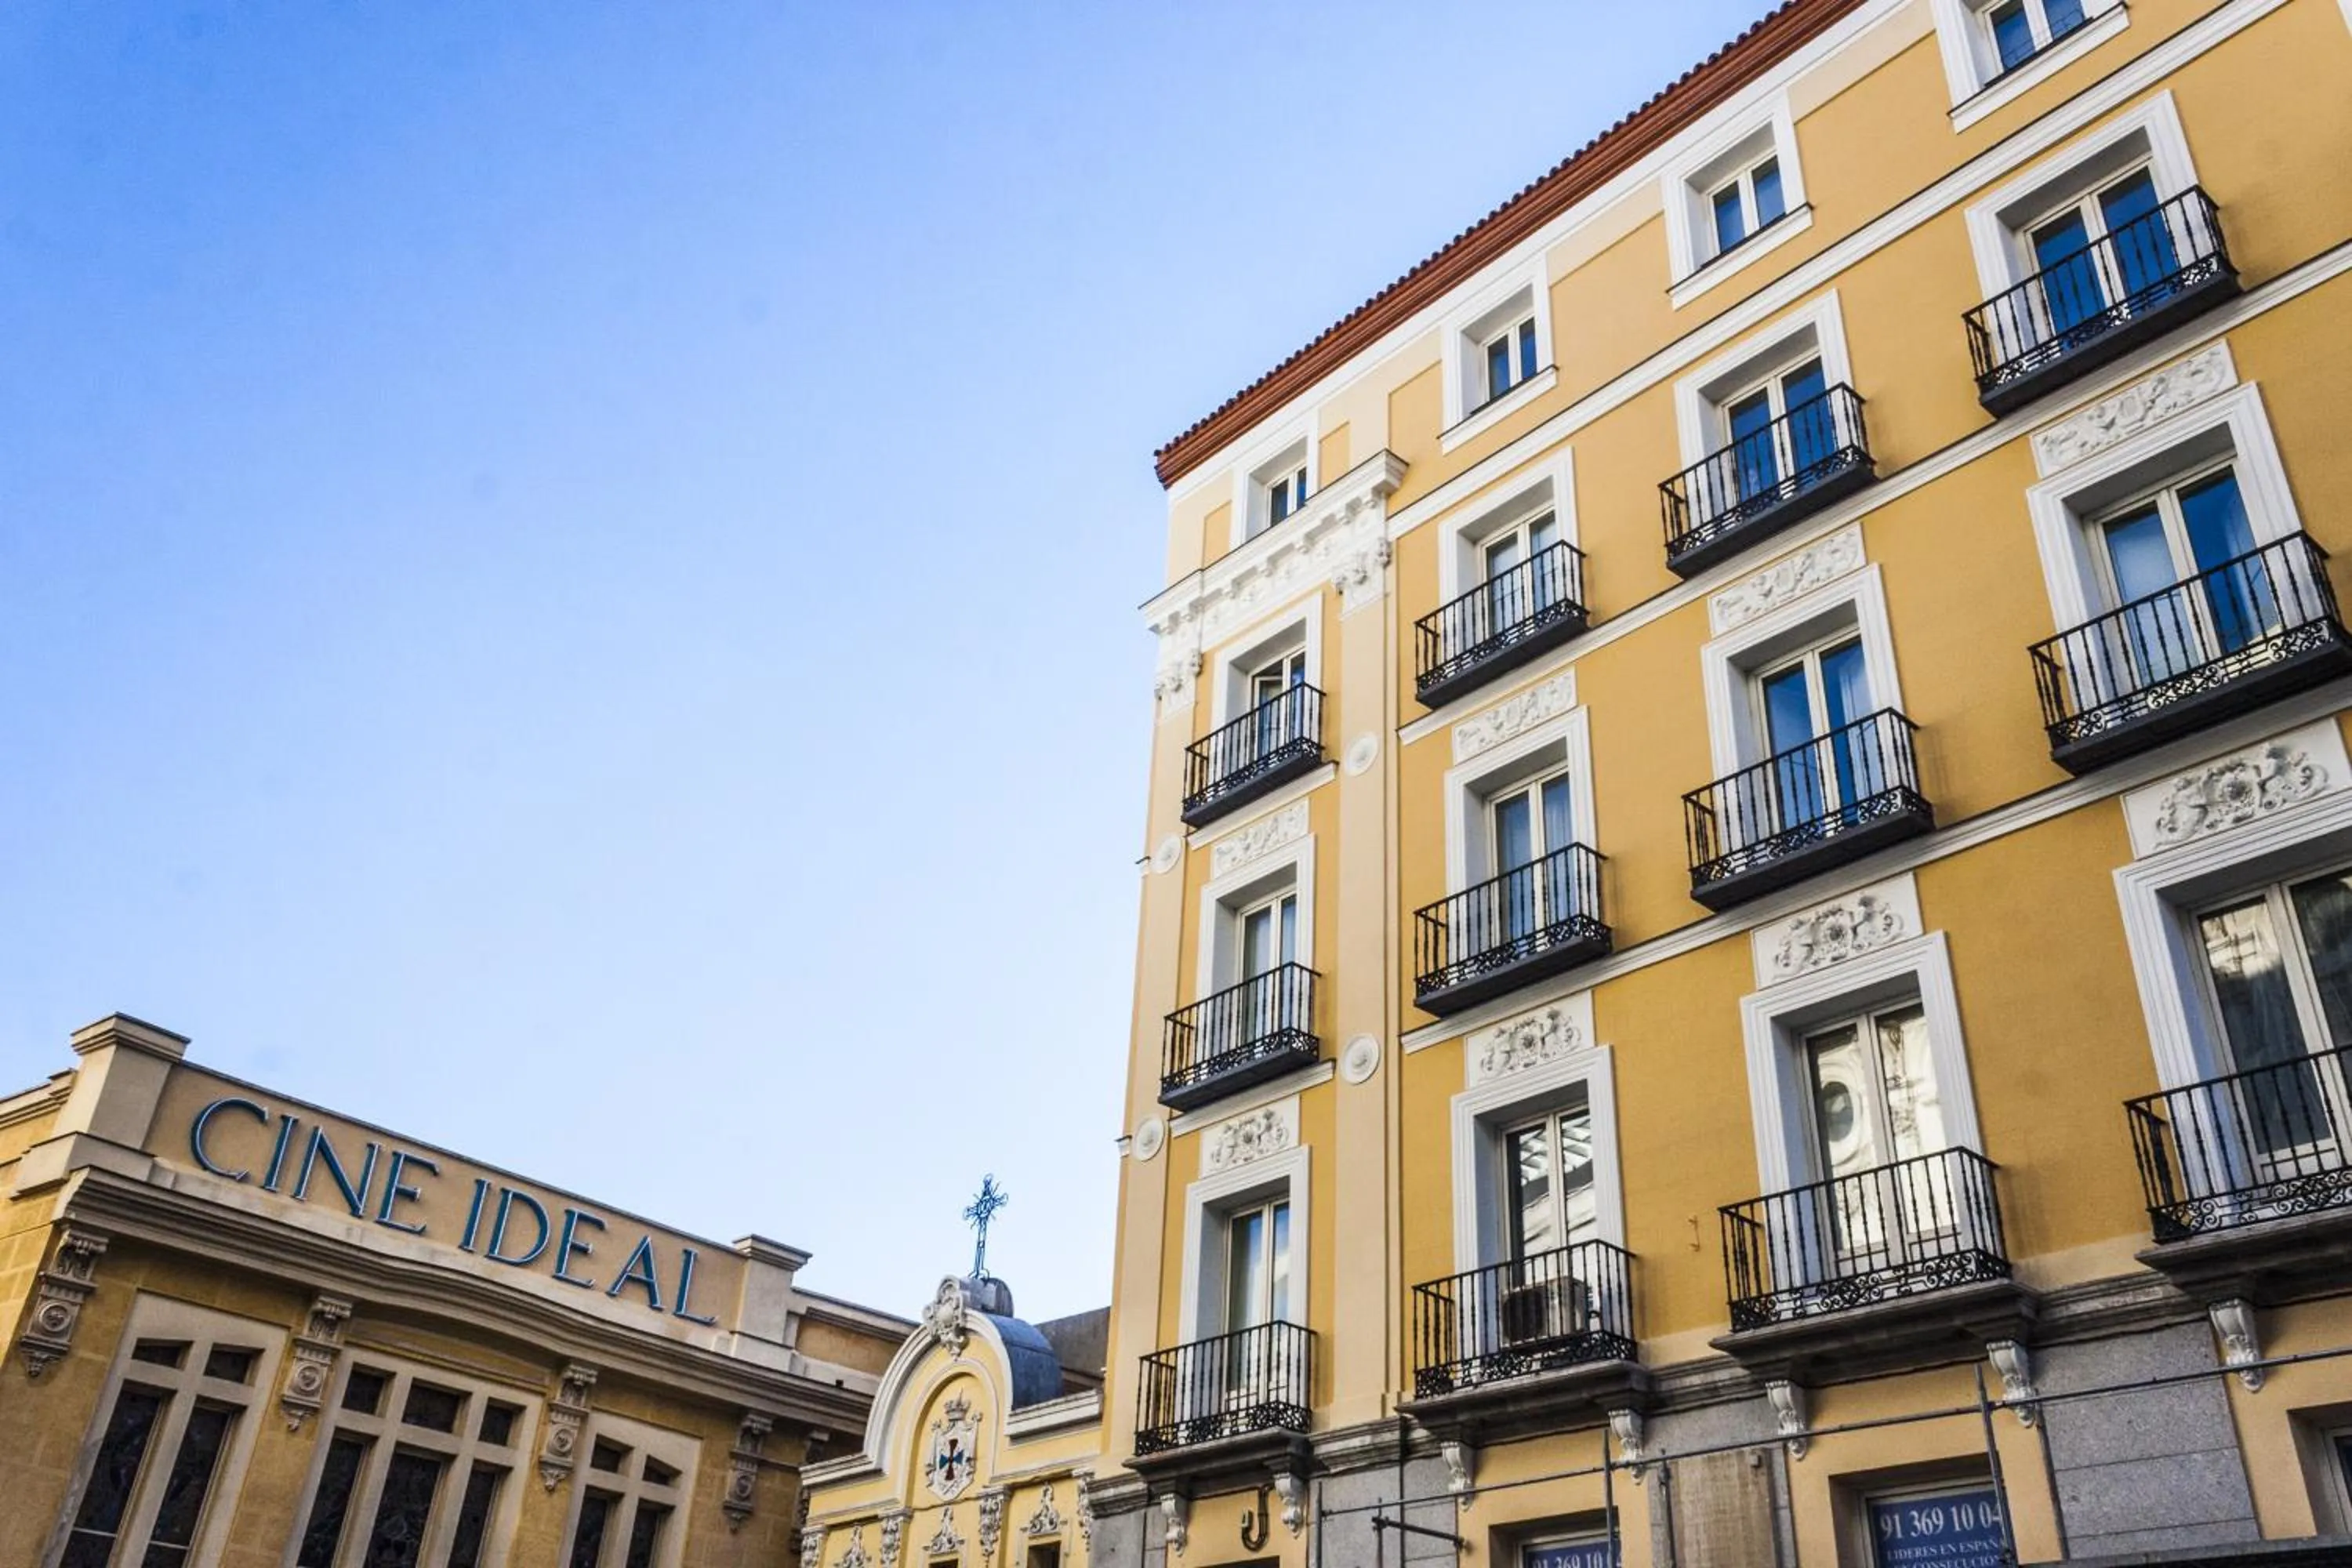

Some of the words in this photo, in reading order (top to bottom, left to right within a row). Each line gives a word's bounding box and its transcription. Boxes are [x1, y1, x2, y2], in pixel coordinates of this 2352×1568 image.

[191, 1097, 440, 1235] CINE
[458, 1178, 718, 1326] IDEAL
[1878, 1513, 1903, 1539] 91
[1908, 1506, 1944, 1538] 369
[1950, 1503, 1974, 1532] 10
